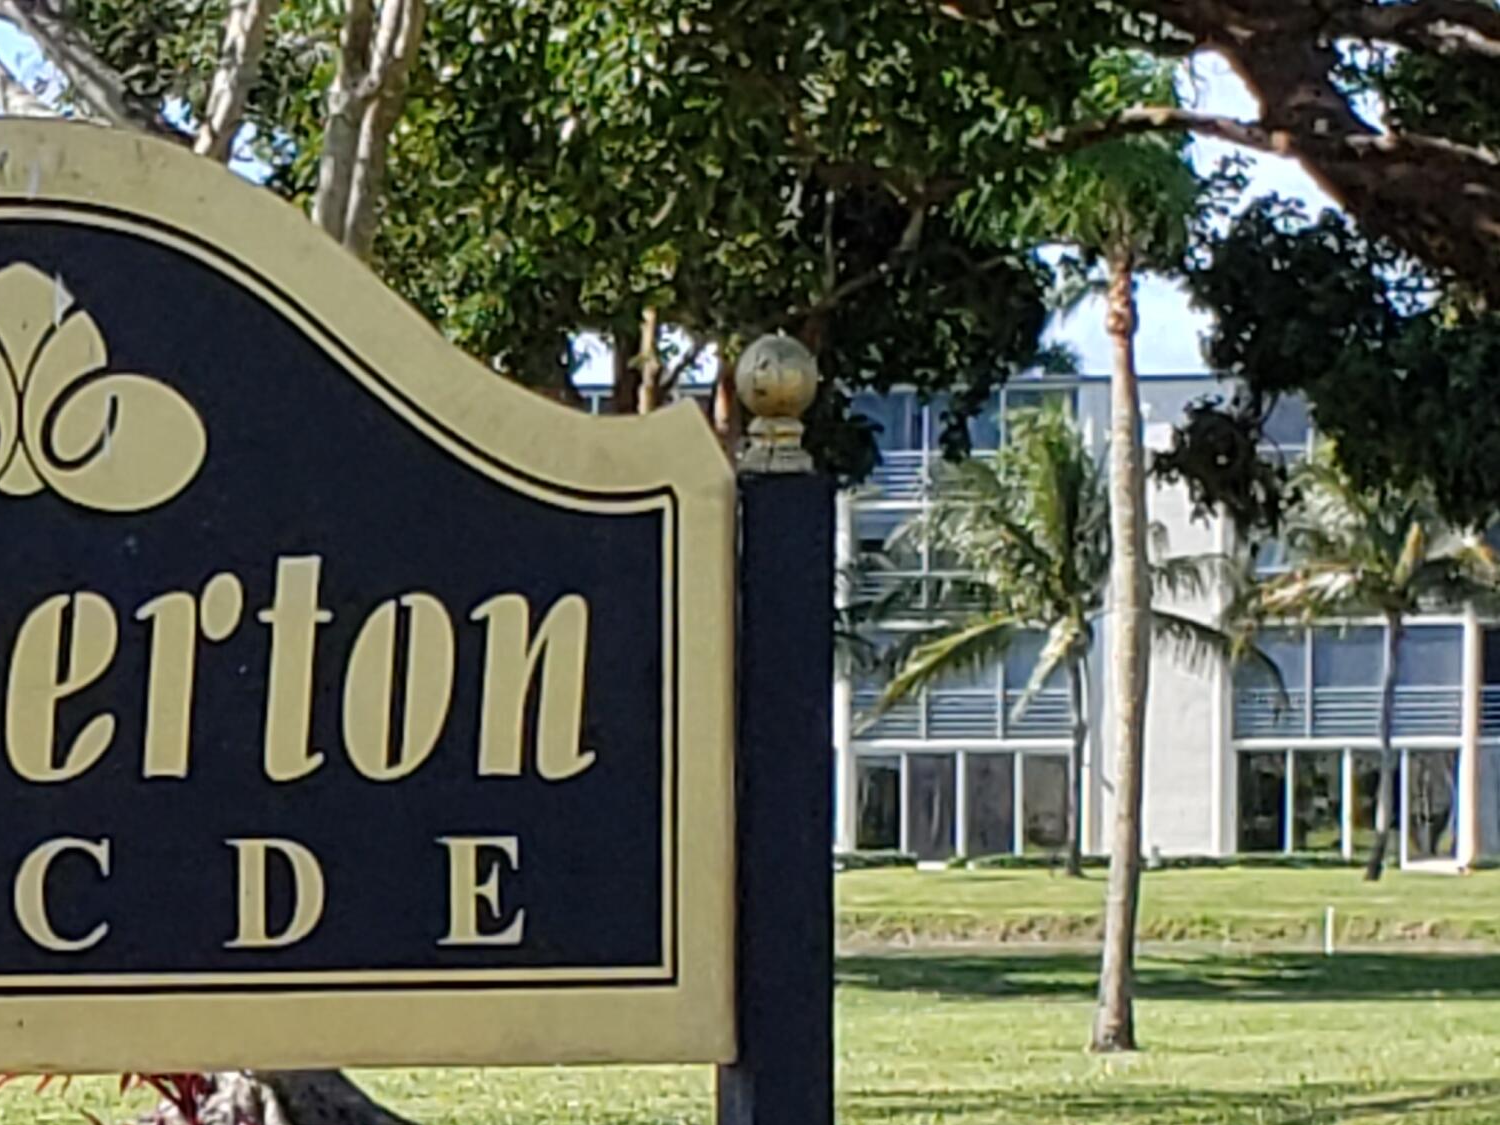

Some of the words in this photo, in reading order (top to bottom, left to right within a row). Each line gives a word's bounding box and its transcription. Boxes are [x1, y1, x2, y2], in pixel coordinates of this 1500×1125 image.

[14, 838, 111, 951] C
[224, 838, 324, 948] D
[437, 836, 525, 946] E
